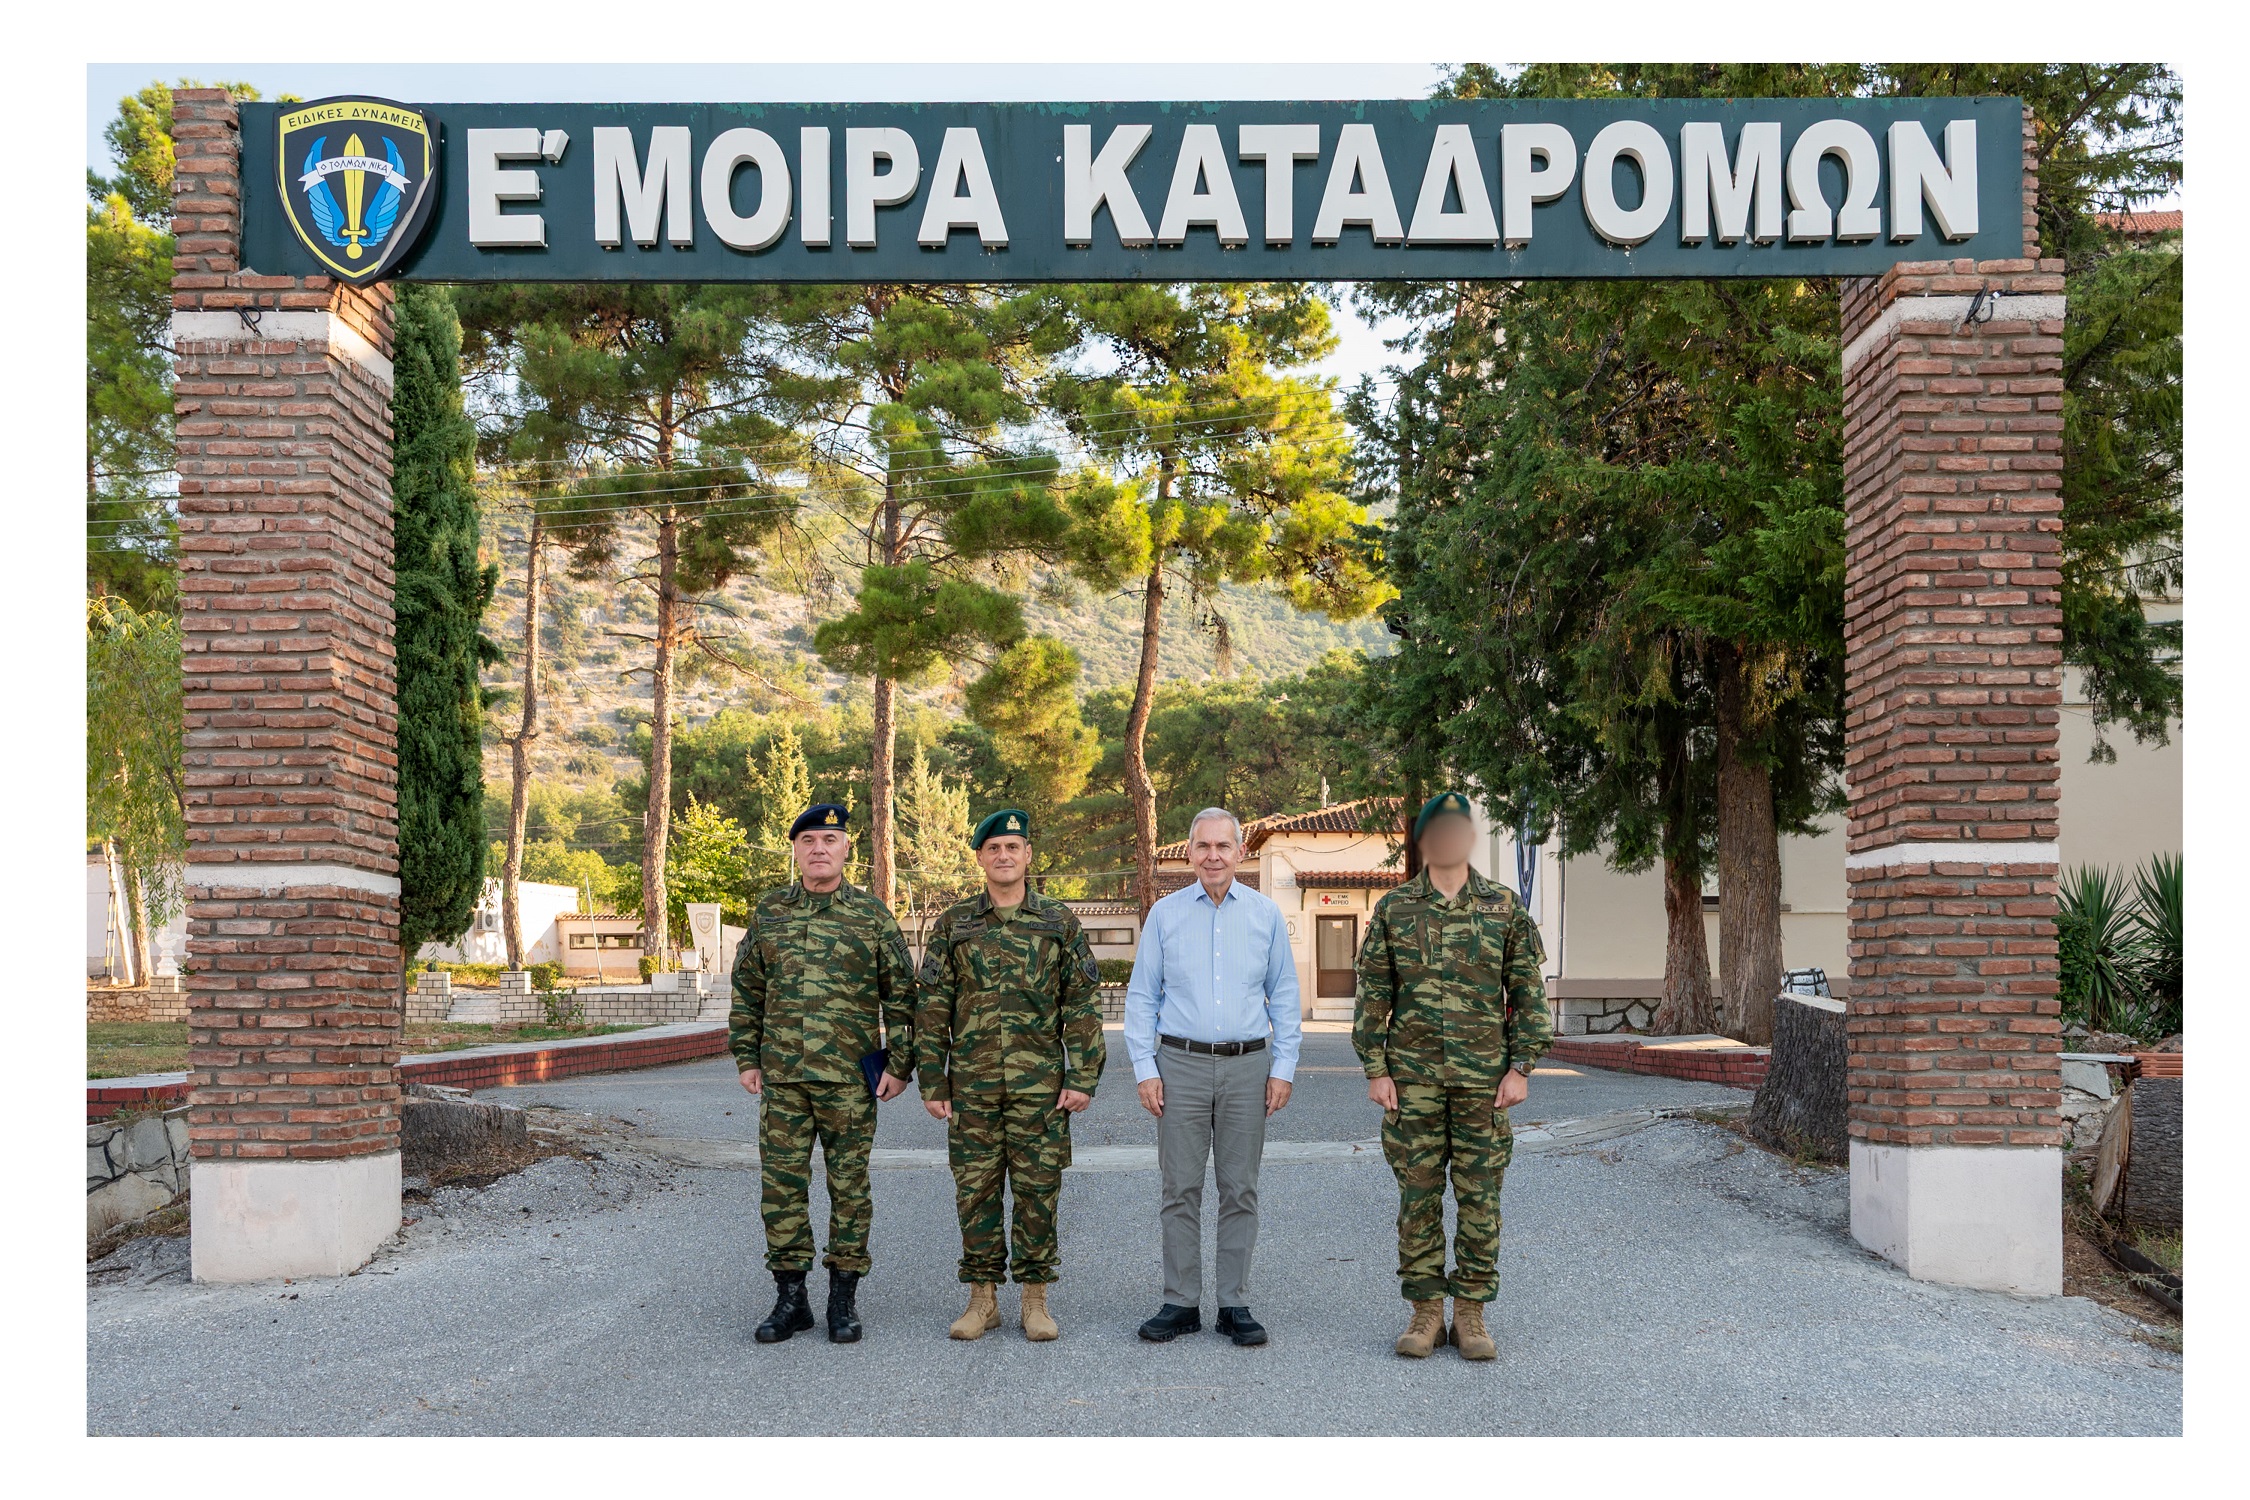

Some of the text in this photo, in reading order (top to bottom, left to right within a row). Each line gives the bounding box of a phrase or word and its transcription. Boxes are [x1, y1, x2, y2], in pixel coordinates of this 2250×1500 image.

[288, 108, 423, 130] ΕΙΔΙΚΕΣ ΔΥΝΑΜΕΙΣ
[320, 158, 388, 173] Ο ΤΟΛΜΩΝ ΝΙΚΑ
[593, 126, 1010, 251] ΜΟΙΡΑ
[1063, 119, 1979, 248] ΚΑΤΑΔΡΟΜΩΝ
